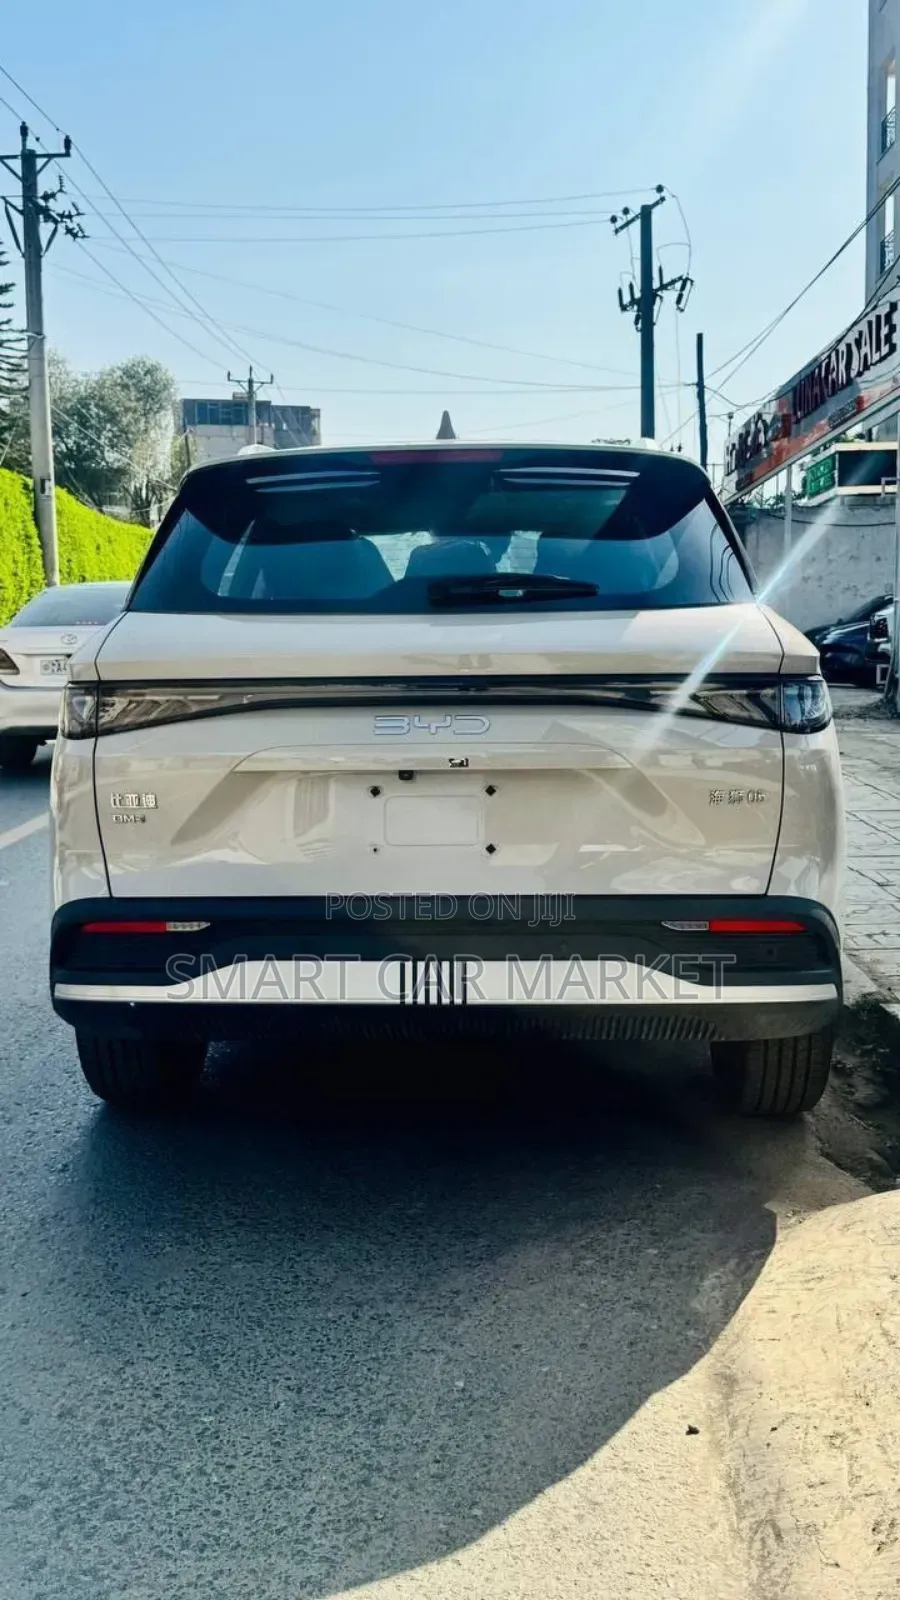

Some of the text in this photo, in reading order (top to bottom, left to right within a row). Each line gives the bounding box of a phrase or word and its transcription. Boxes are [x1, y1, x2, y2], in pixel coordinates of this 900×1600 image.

[820, 343, 852, 397] CAR
[849, 301, 898, 379] SALE
[374, 715, 490, 735] BYD
[110, 791, 158, 809] 比亚迪
